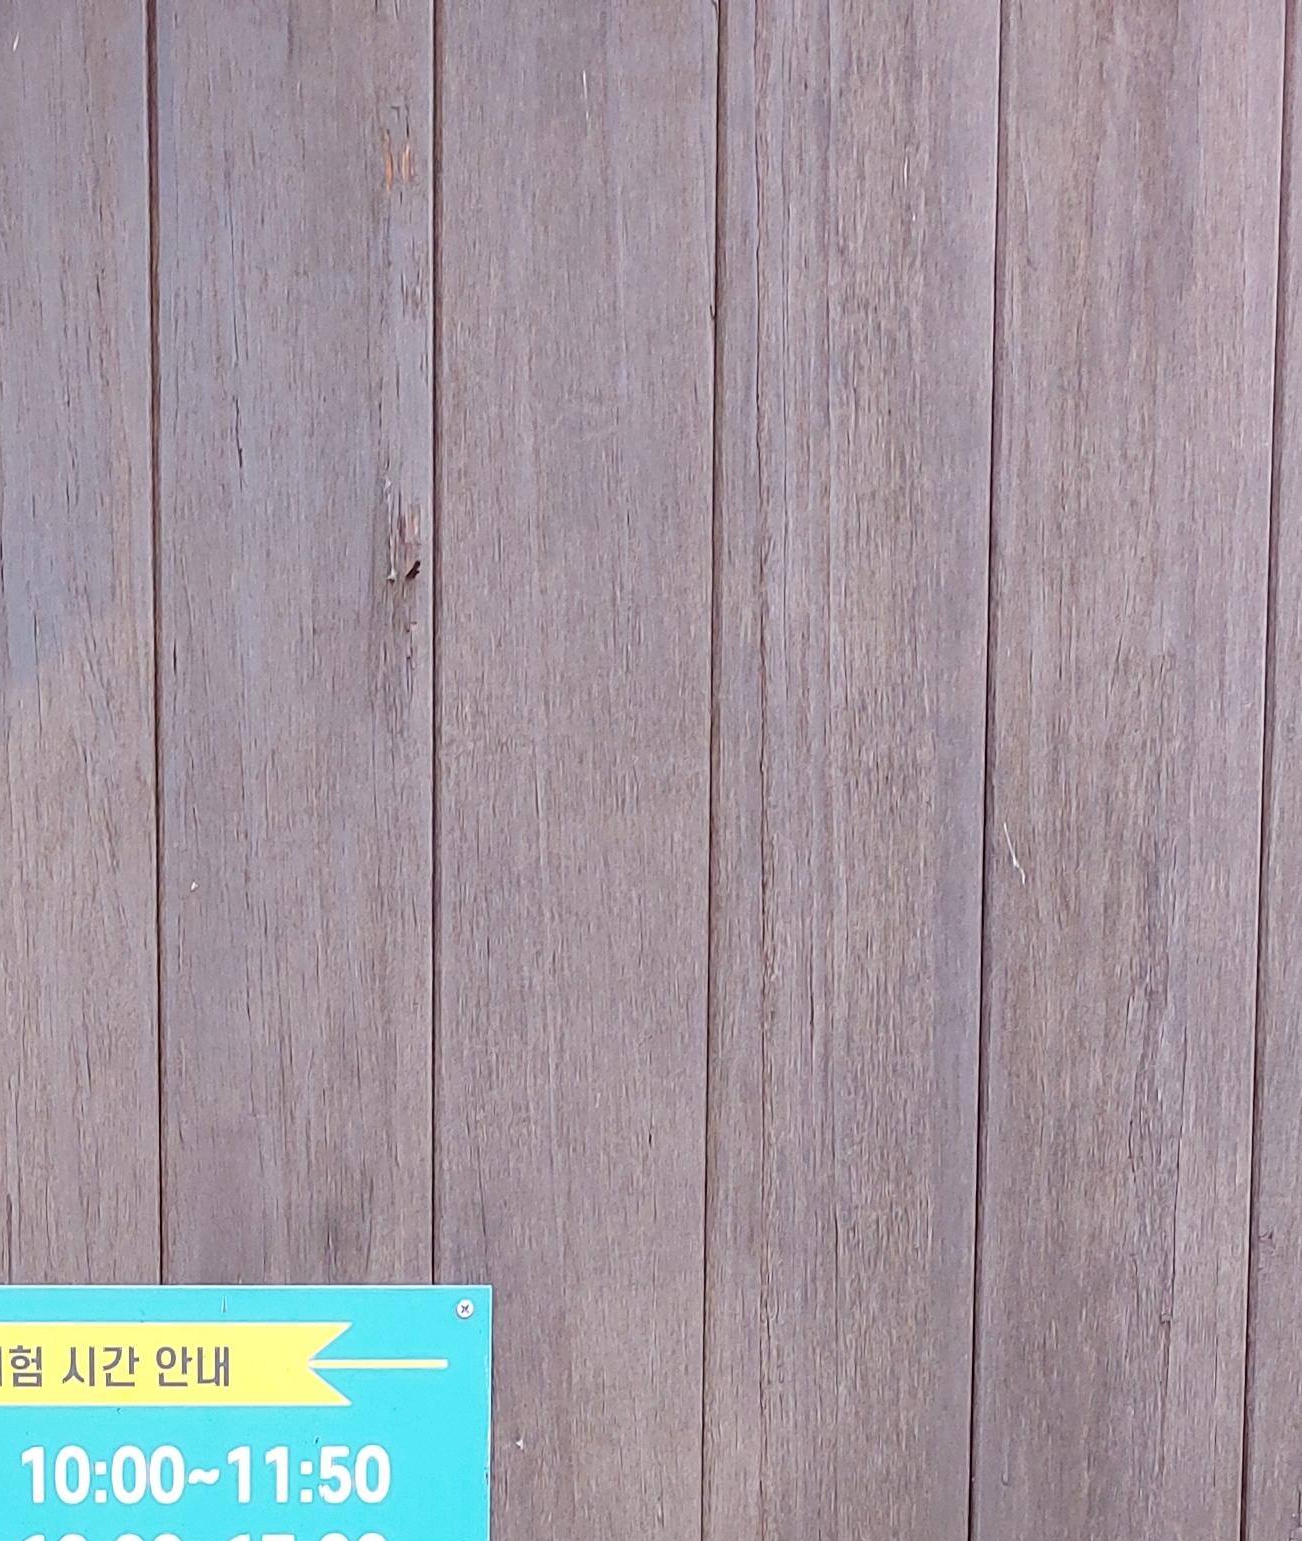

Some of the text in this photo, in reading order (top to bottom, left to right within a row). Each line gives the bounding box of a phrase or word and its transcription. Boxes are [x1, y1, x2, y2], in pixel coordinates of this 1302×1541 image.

[61, 1346, 139, 1389] 시간
[156, 1345, 232, 1388] 안내
[19, 1444, 392, 1506] 10:00~11:50
